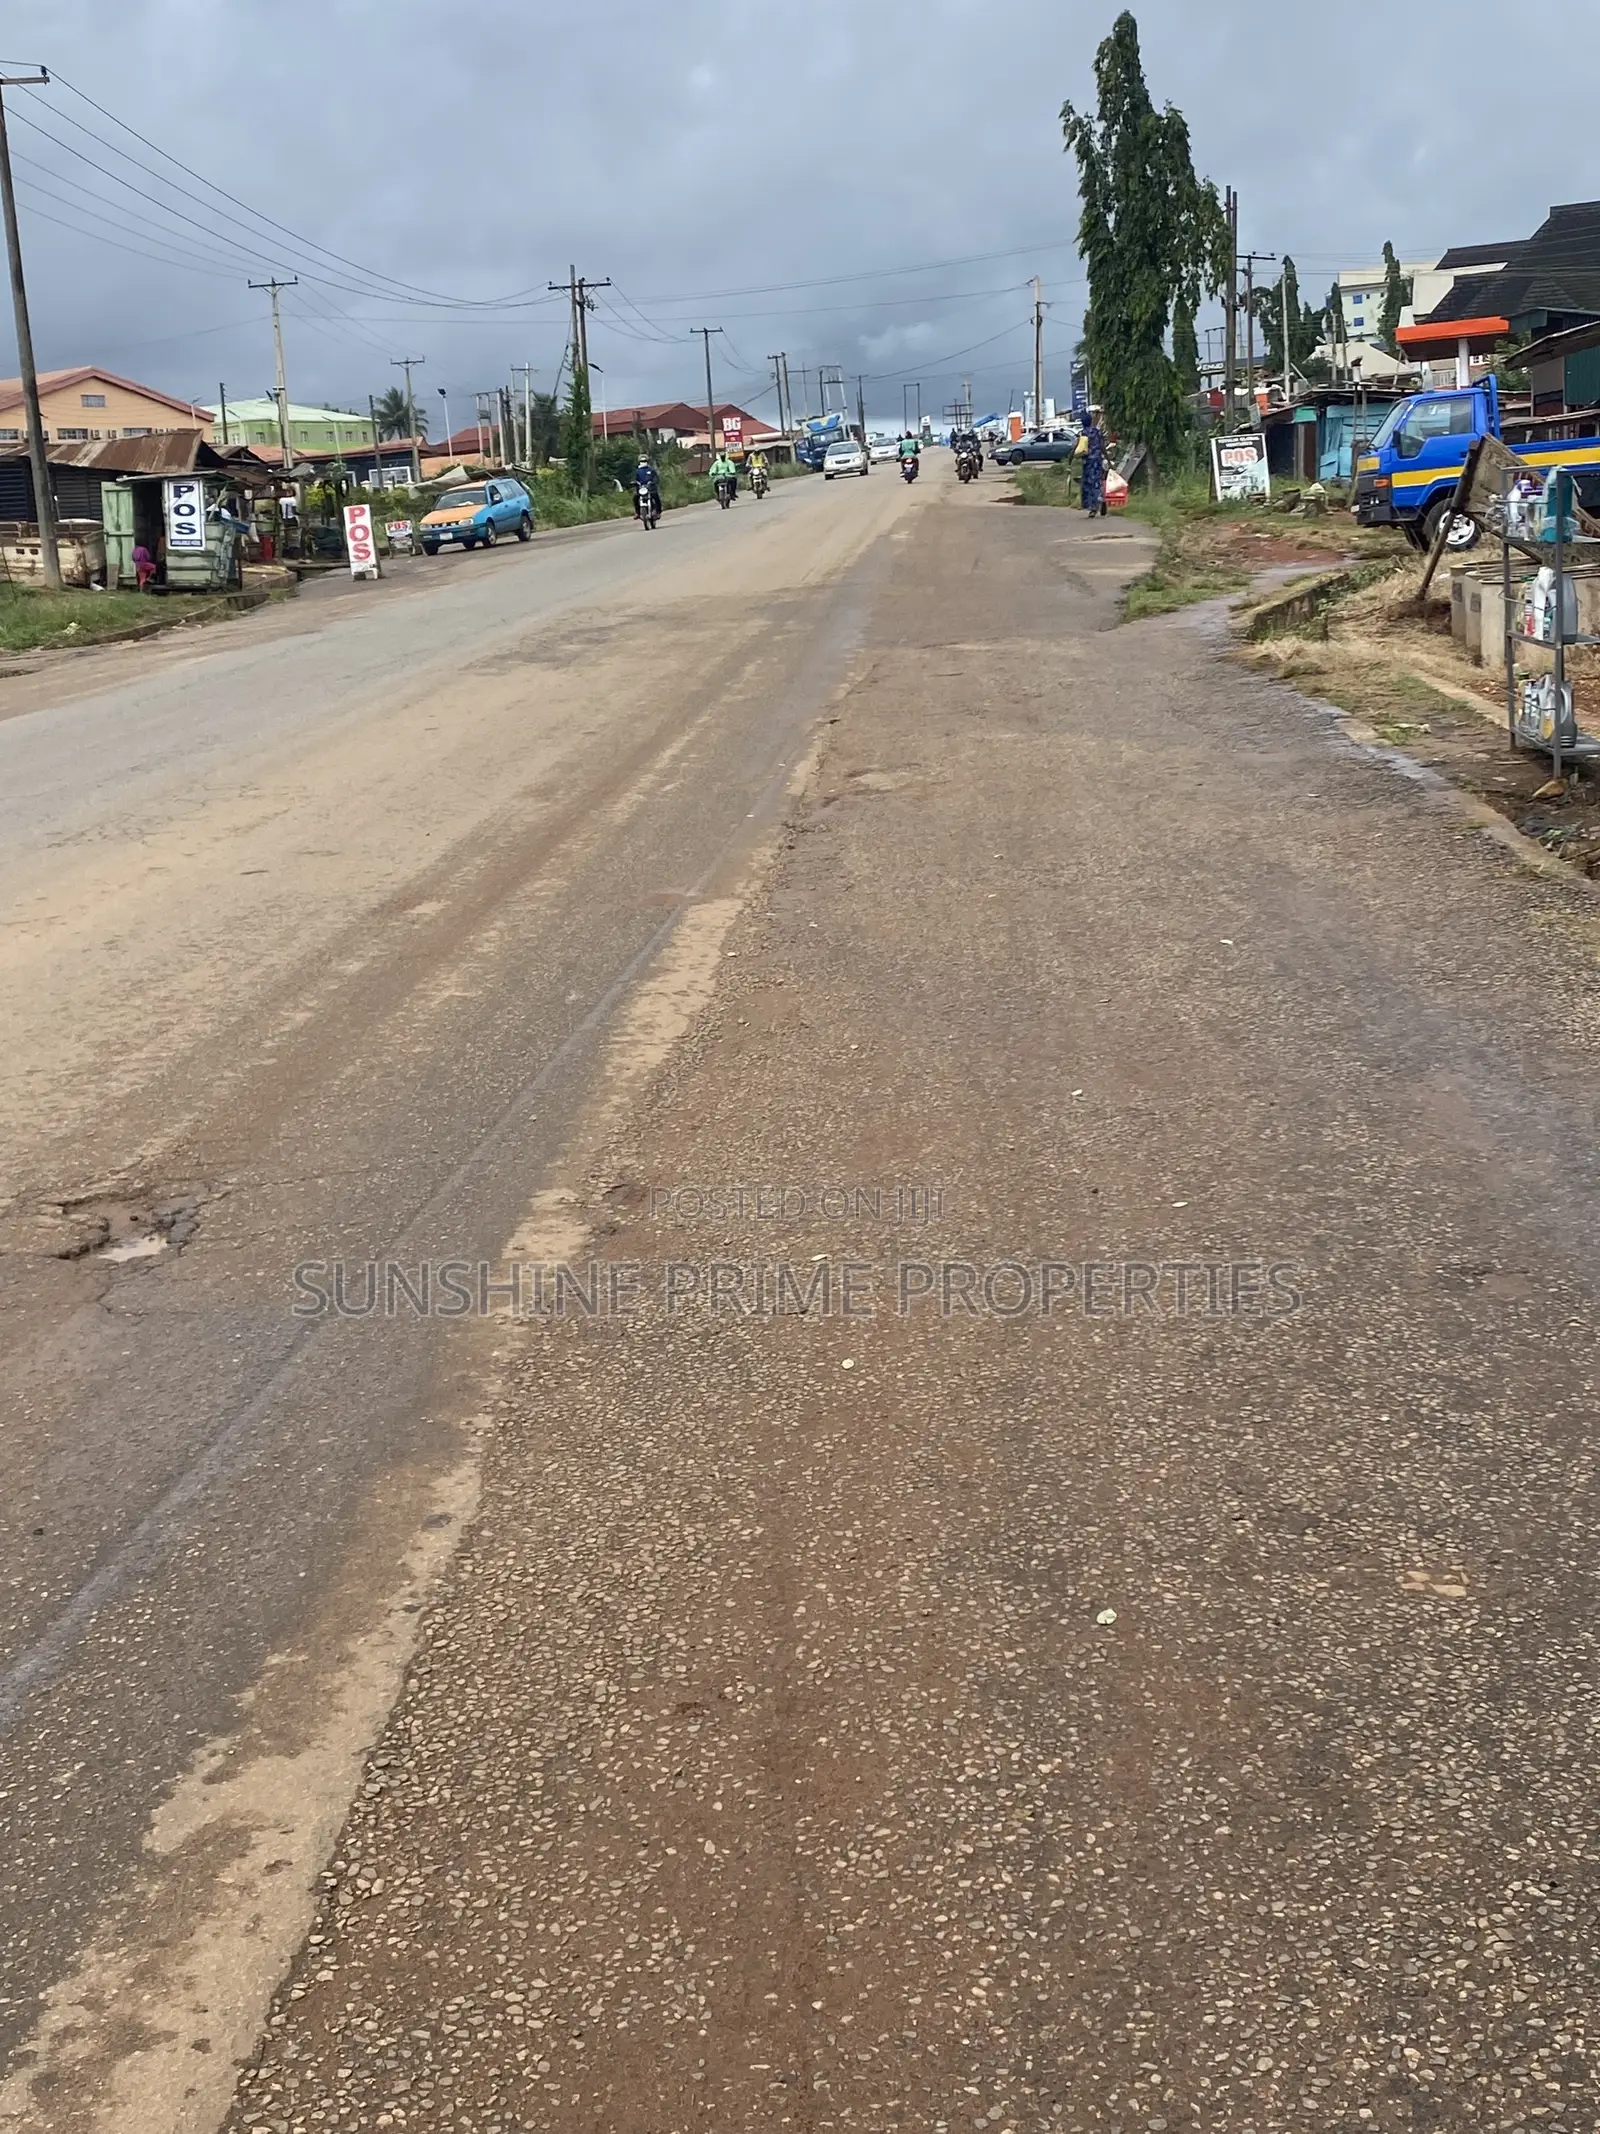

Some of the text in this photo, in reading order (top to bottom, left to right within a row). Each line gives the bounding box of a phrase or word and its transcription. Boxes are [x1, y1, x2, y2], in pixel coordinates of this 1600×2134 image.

[722, 417, 741, 431] BG
[1222, 448, 1257, 465] POS
[173, 485, 197, 535] POS
[348, 506, 371, 560] POS
[387, 521, 408, 530] POS
